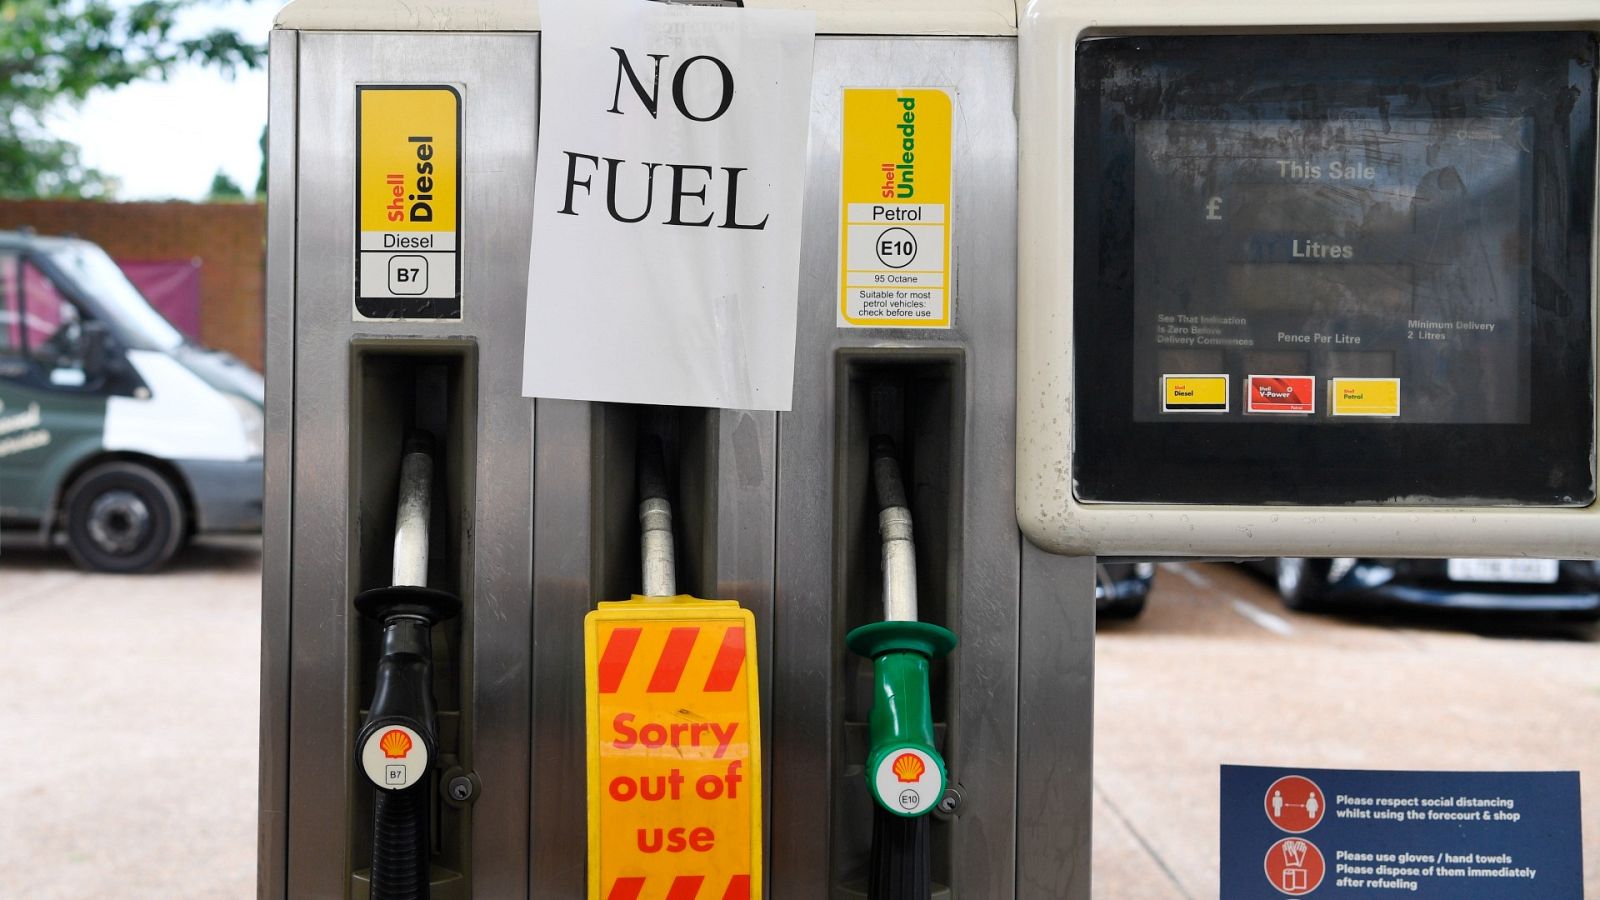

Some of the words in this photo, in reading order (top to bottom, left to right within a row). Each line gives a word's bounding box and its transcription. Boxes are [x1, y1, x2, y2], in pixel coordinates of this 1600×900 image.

[606, 46, 735, 122] NO
[896, 97, 915, 198] Unleaded
[1276, 160, 1321, 180] This
[1328, 161, 1376, 180] Sale
[408, 136, 433, 222] Diesel
[881, 163, 894, 198] Shell
[556, 150, 769, 230] FUEL
[386, 174, 404, 222] Shell
[873, 206, 921, 221] Petrol
[1206, 196, 1223, 221] £
[384, 233, 433, 248] Diesel
[881, 241, 913, 256] E10
[1292, 239, 1354, 259] Litres
[397, 268, 419, 282] B7
[874, 275, 885, 283] 95
[887, 275, 918, 283] Octane
[859, 291, 894, 299] Suitable
[896, 291, 908, 299] for
[910, 291, 931, 299] most
[863, 300, 887, 310] petrol
[858, 309, 884, 317] check
[886, 309, 913, 317] before
[1158, 314, 1175, 323] See
[1177, 314, 1198, 324] That
[1200, 315, 1247, 325] Indation
[1168, 325, 1188, 334] Zero
[1408, 319, 1453, 329] Minimum
[1456, 321, 1495, 332] Delivery
[1157, 335, 1195, 346] Delivery
[1278, 332, 1311, 343] Pence
[1314, 333, 1332, 343] Per
[1335, 333, 1361, 344] Litre
[1407, 330, 1414, 340] 2
[1418, 331, 1446, 340] Litres
[612, 712, 739, 758] Sorry
[390, 770, 402, 779] B7
[608, 768, 684, 802] out
[696, 759, 743, 800] of
[901, 795, 917, 804] E10
[1336, 795, 1373, 806] Please
[1375, 796, 1419, 808] respect
[1421, 797, 1454, 807] social
[1456, 797, 1514, 809] distancing
[1336, 808, 1371, 819] whilst
[1373, 809, 1404, 821] using
[1407, 810, 1425, 820] the
[1427, 810, 1481, 821] forecourt
[1482, 811, 1491, 821] &
[1493, 811, 1520, 822] shop
[637, 826, 715, 853] use
[1336, 850, 1373, 862] Please
[1376, 853, 1396, 862] use
[1398, 852, 1435, 864] gloves
[1437, 852, 1443, 864] /
[1445, 853, 1473, 864] hand
[1475, 853, 1512, 864] towels
[1336, 863, 1373, 875] Please
[1375, 865, 1420, 877] dispose
[1422, 865, 1434, 876] of
[1436, 866, 1465, 877] them
[1467, 866, 1536, 879] immediately
[1336, 877, 1364, 888] after
[1366, 878, 1418, 891] refueling
